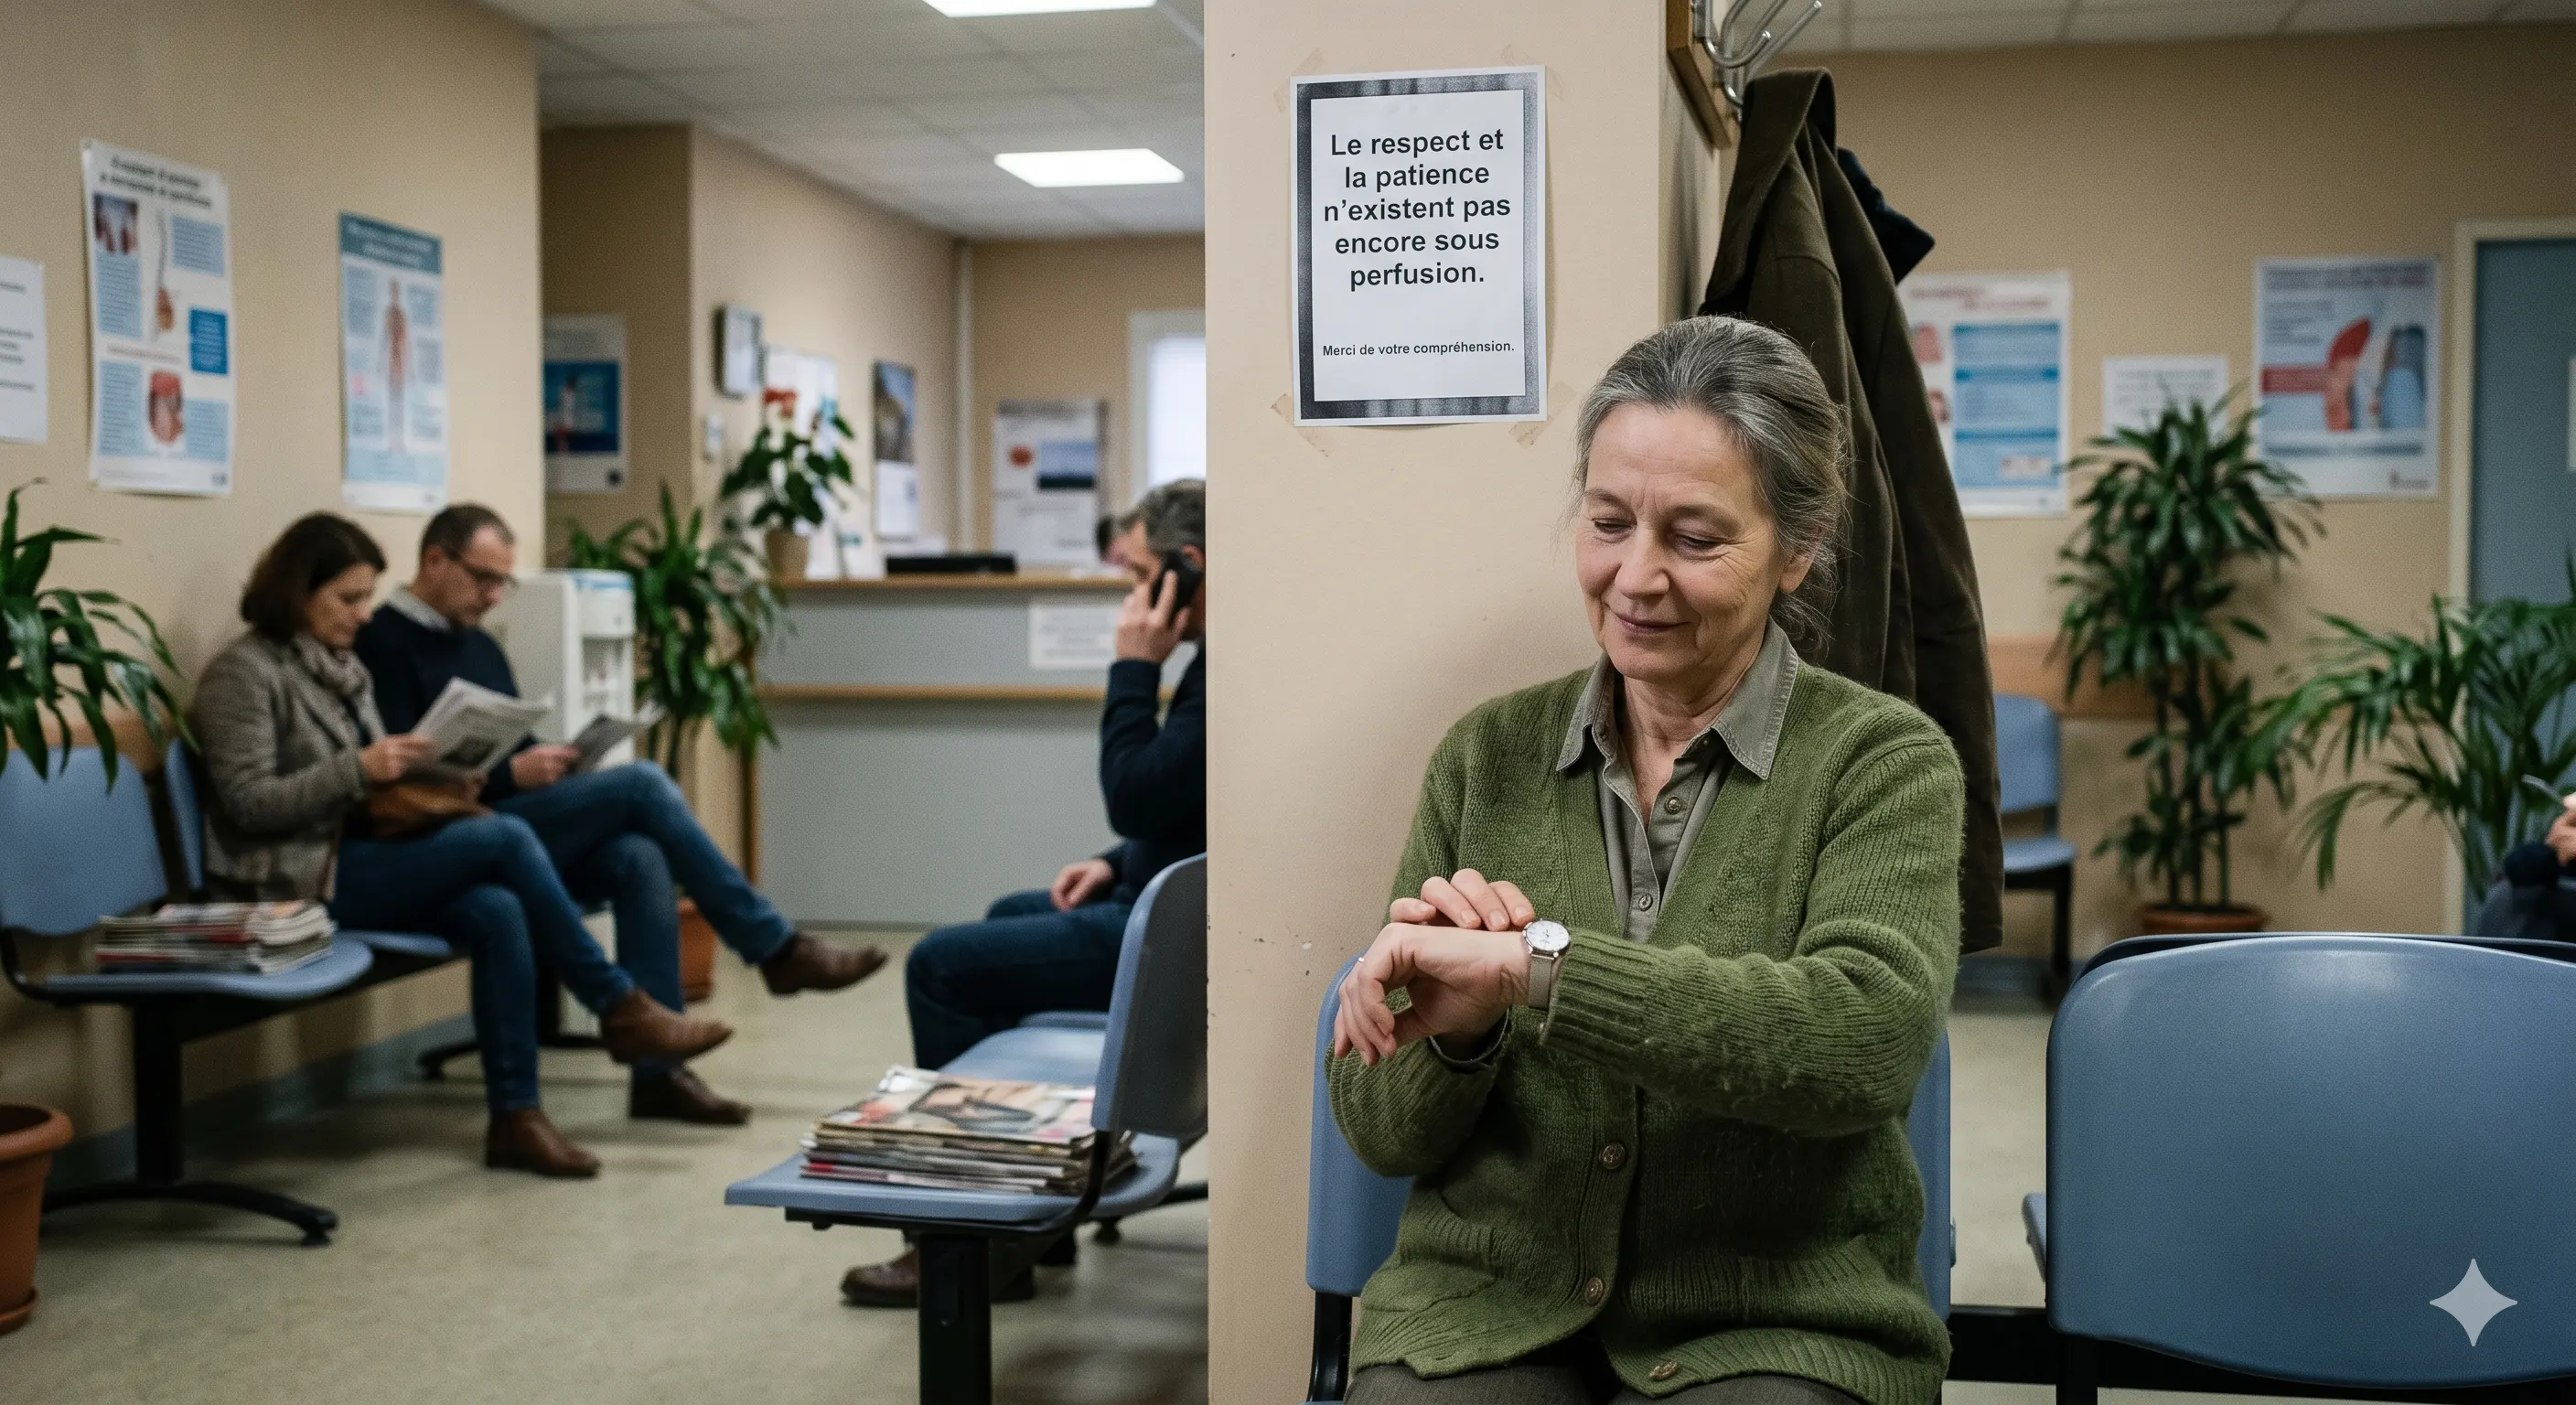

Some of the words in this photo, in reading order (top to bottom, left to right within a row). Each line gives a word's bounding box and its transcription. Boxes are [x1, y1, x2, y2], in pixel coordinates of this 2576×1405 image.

[1332, 134, 1362, 156] Le
[1371, 130, 1471, 159] respect
[1478, 128, 1504, 151] et
[1346, 166, 1367, 188] la
[1376, 163, 1490, 192] patience
[1464, 198, 1511, 223] pas
[1335, 235, 1426, 254] encore
[1434, 232, 1499, 252] sous
[1350, 262, 1484, 292] perfusion.
[1323, 344, 1356, 356] Merci
[1359, 344, 1375, 355] de
[1378, 344, 1410, 355] votre
[1413, 340, 1515, 356] compréhension.
